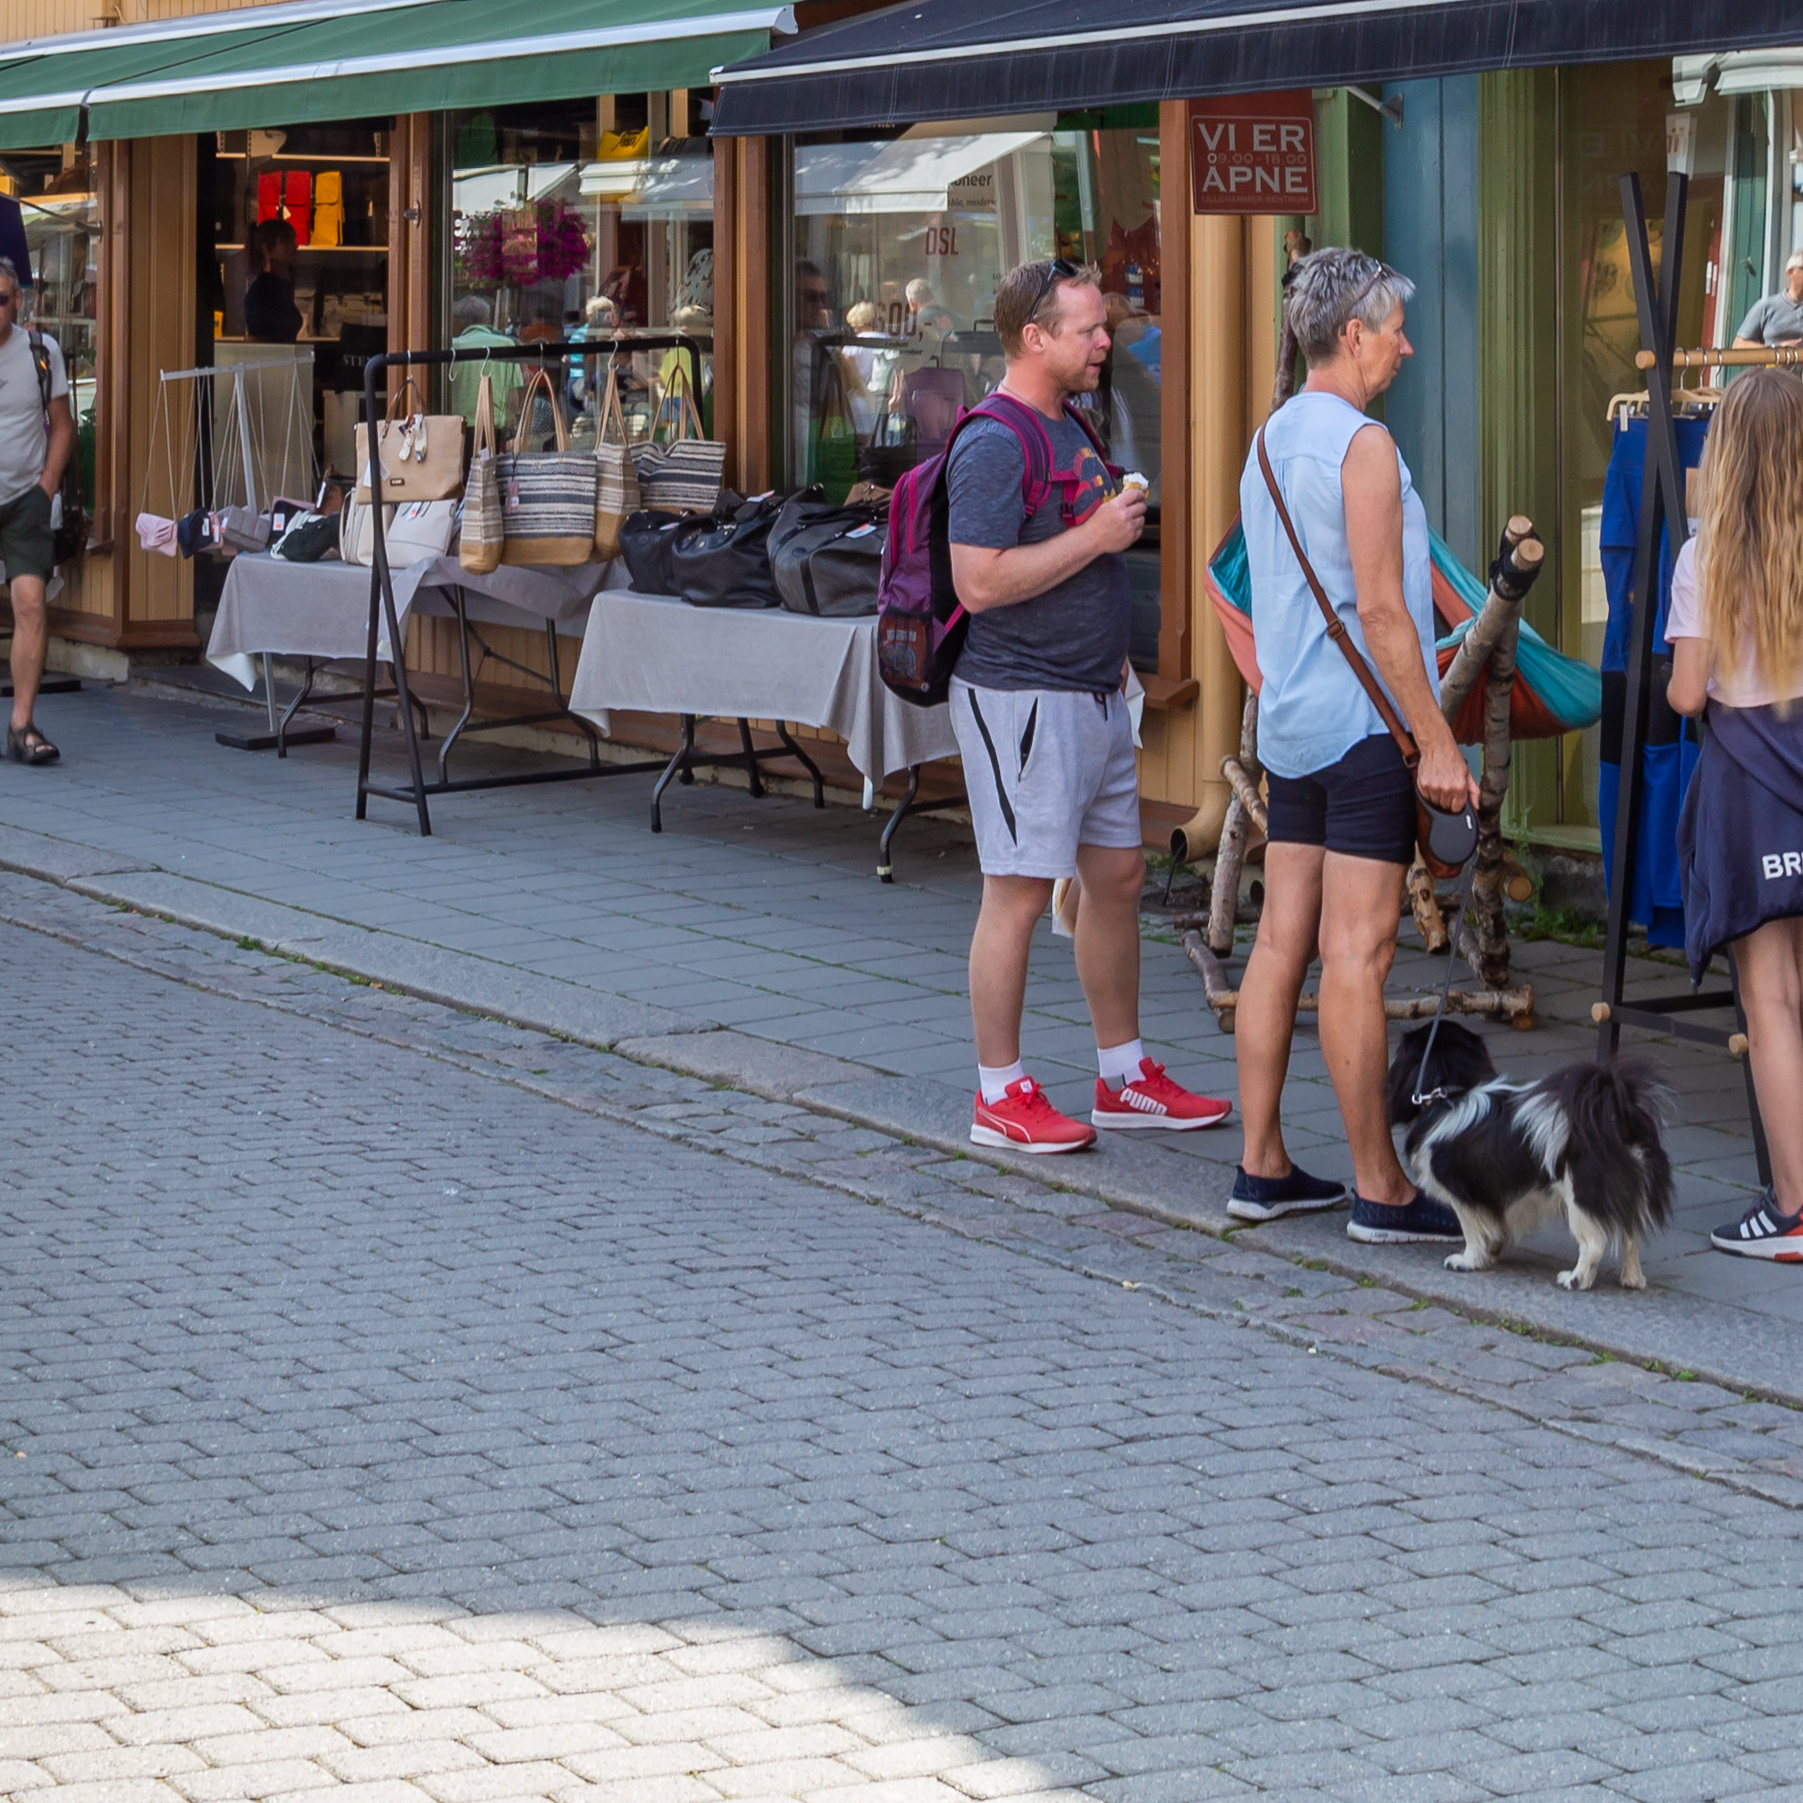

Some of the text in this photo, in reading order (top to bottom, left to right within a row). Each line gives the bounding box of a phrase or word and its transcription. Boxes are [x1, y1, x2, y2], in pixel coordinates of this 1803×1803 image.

[1198, 123, 1305, 152] VI ER
[950, 174, 992, 187] oneer
[1119, 1087, 1168, 1116] PUMA
